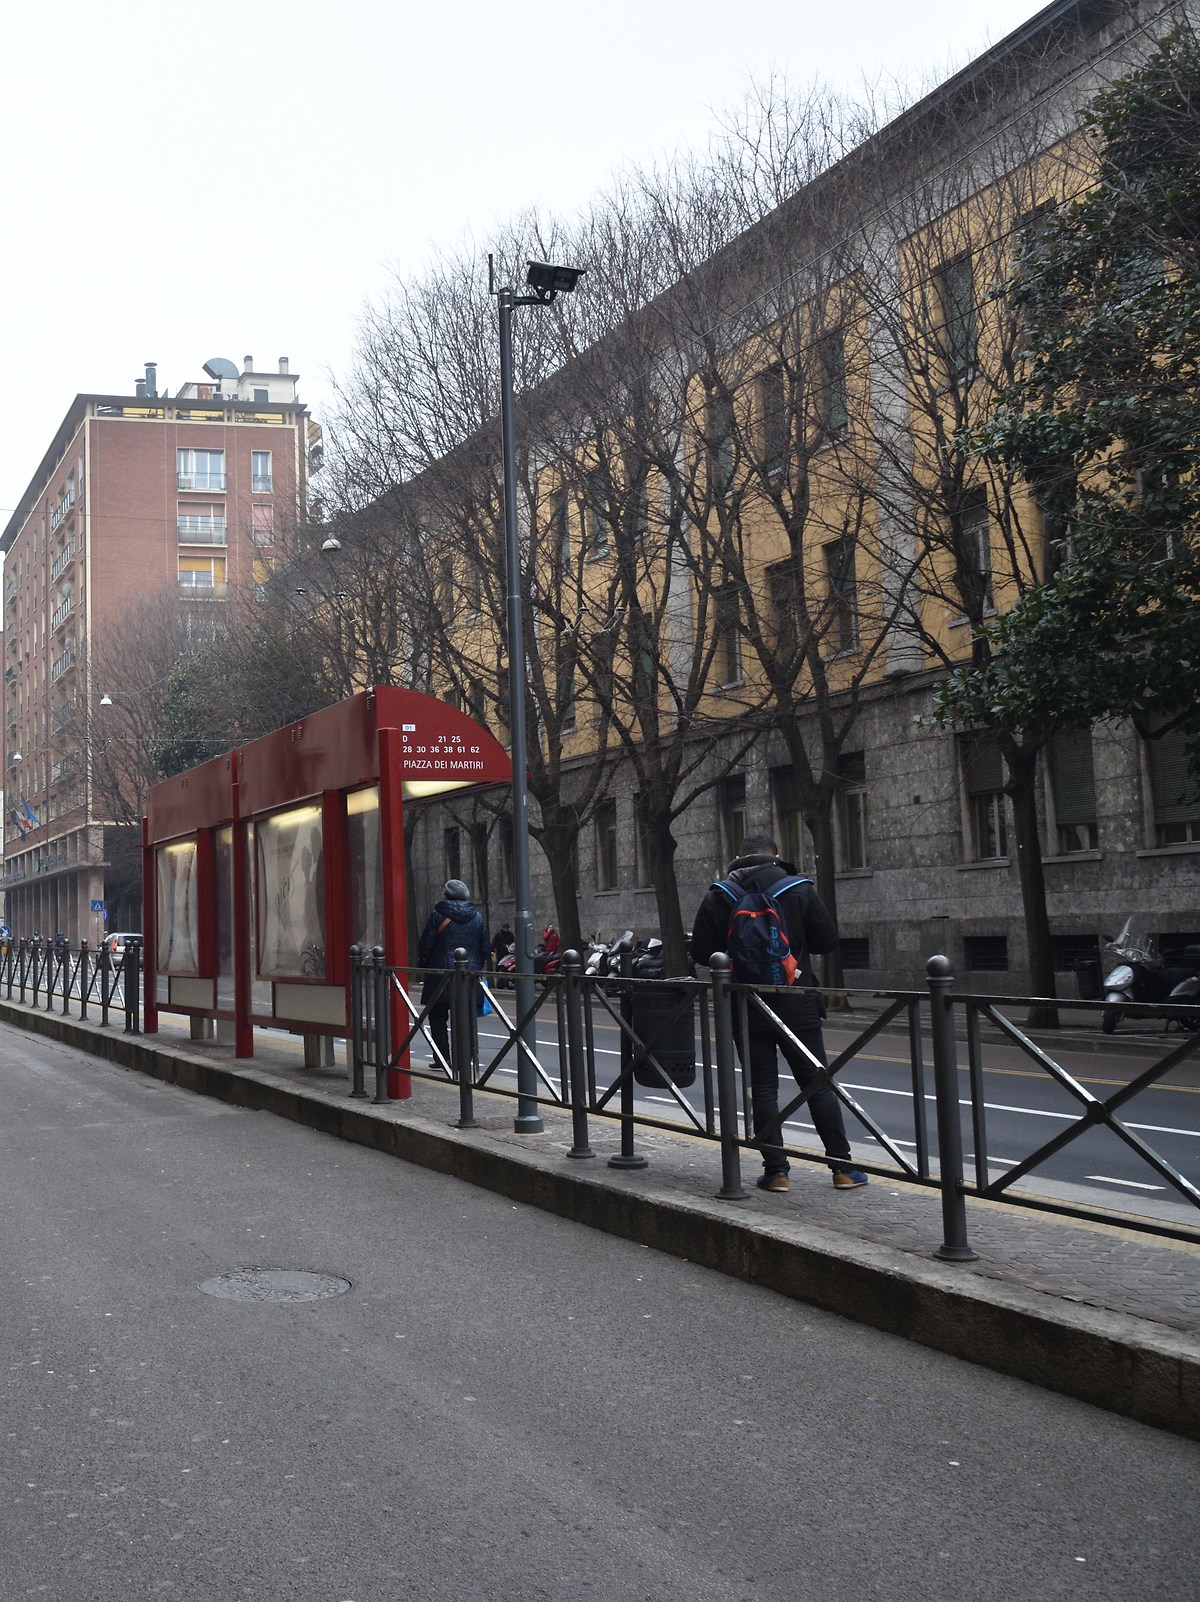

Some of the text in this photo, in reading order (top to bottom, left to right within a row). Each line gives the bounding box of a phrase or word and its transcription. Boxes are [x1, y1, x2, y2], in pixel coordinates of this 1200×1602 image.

[402, 735, 461, 743] D 21 25
[402, 745, 480, 753] 28 30 36 38 61 62
[403, 760, 484, 770] PIAZZA DEI MARTIRI
